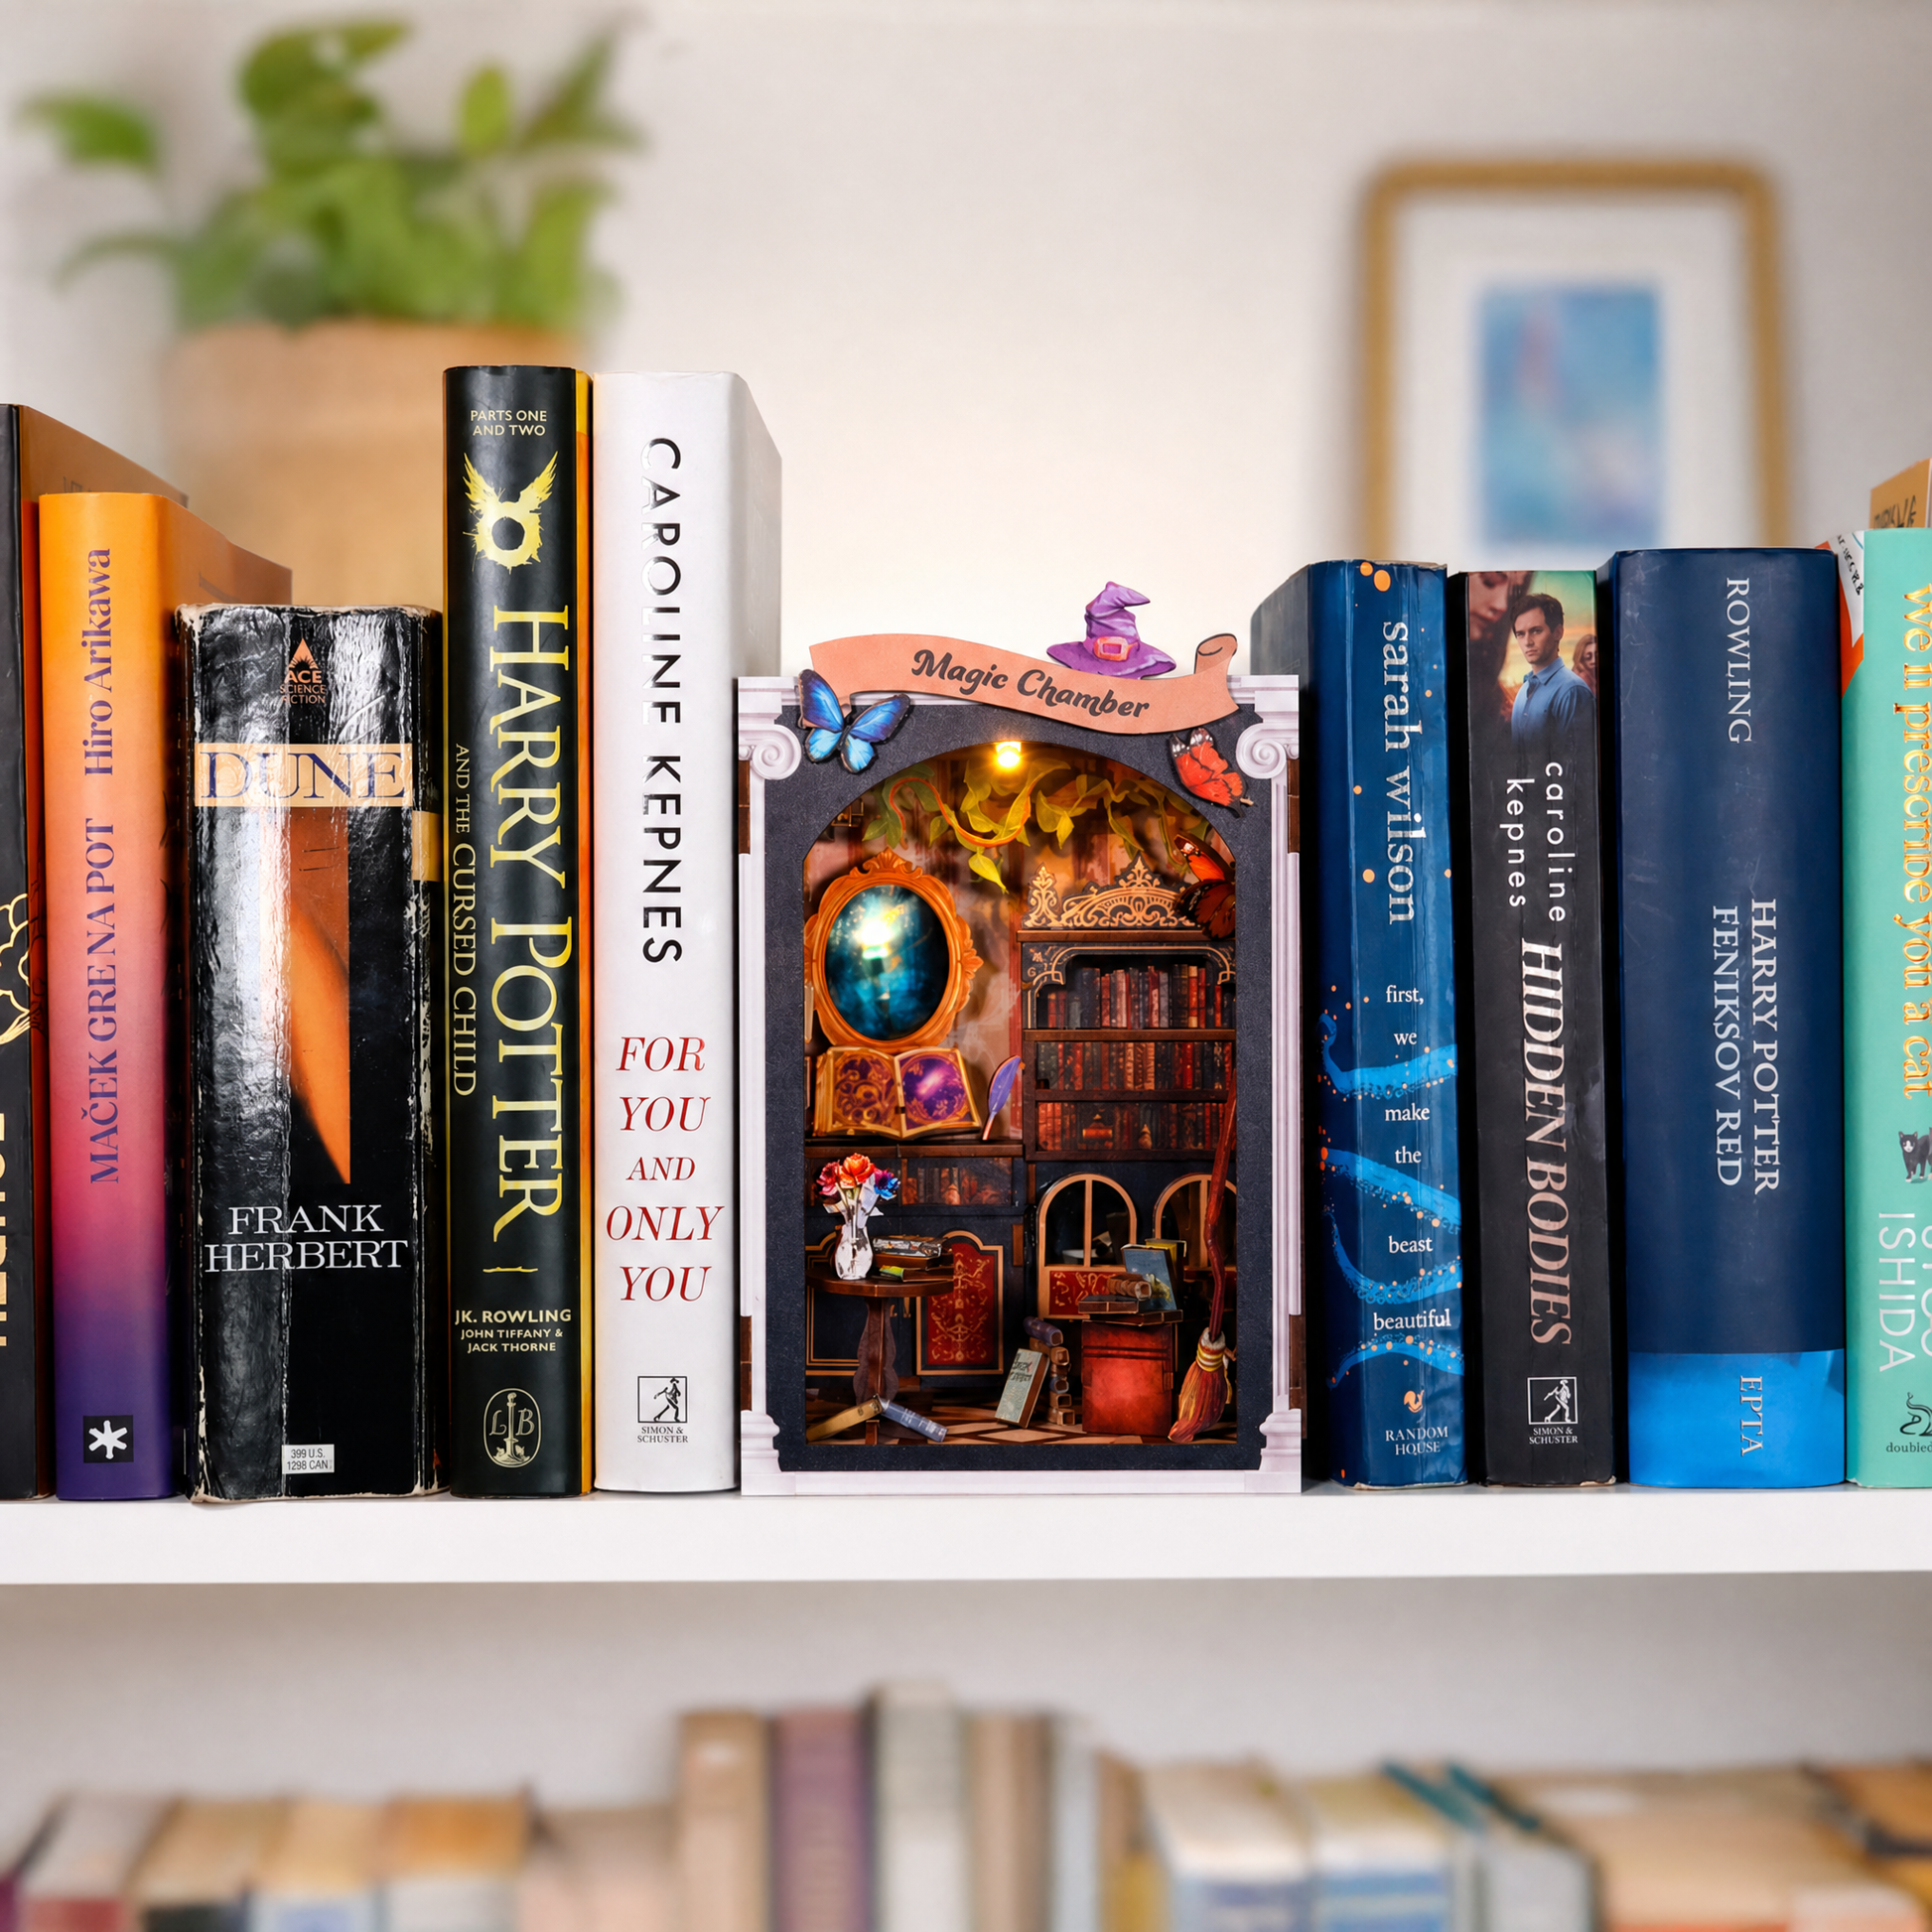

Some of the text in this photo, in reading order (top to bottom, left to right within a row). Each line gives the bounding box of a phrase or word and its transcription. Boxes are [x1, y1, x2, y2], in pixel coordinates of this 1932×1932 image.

[470, 409, 547, 422] PARTS ONE
[473, 424, 546, 437] AND TWO
[81, 547, 113, 776] Hiro Arikawa
[1725, 576, 1752, 745] ROWLING
[279, 684, 327, 695] SCIENCE
[284, 669, 323, 684] ACE
[910, 648, 1151, 718] Magic Chamber
[640, 437, 682, 963] CAROLINE KEPNES
[200, 751, 405, 799] DUNE
[1382, 621, 1427, 925] sarah wilson
[1499, 777, 1535, 908] kepnes
[1544, 761, 1576, 923] caroline
[453, 744, 478, 1097] AND THE CURSED CHILD
[489, 605, 573, 1243] HARRY POTTER
[1893, 910, 1932, 991] you
[80, 817, 118, 1184] MAČEK GRE NA POT
[1385, 985, 1425, 1005] first,
[1903, 1001, 1931, 1026] a
[1393, 1030, 1418, 1045] we
[1713, 904, 1743, 1186] FENIKSOV RED
[1750, 897, 1780, 1195] HARRY POTTER
[616, 1035, 706, 1072] FOR
[1903, 1035, 1932, 1100] cat
[620, 1096, 711, 1133] YOU
[1384, 1103, 1431, 1122] make
[1394, 1147, 1422, 1165] the
[1521, 937, 1572, 1346] HIDDEN BODIES
[626, 1156, 696, 1181] AND
[227, 1204, 384, 1235] FRANK
[606, 1204, 725, 1242] ONLY
[204, 1240, 409, 1273] HERBERT
[1388, 1235, 1434, 1254] beast
[620, 1265, 712, 1303] YOU
[1878, 1212, 1916, 1373] ISHIDA
[454, 1309, 572, 1325] JK. ROWLING
[1373, 1309, 1451, 1331] beautiful
[461, 1328, 563, 1340] JOHN TIFFANY &
[467, 1342, 557, 1354] JACK THORNE
[515, 1407, 535, 1437] B
[640, 1426, 684, 1435] SIMON &
[1738, 1374, 1763, 1457] EPTA
[636, 1435, 689, 1444] SCHUSTER
[1385, 1426, 1449, 1442] RANDOM
[1529, 1435, 1579, 1445] SCHUSTER
[1533, 1426, 1574, 1436] SIMON &
[290, 1449, 307, 1459] 399
[1395, 1441, 1441, 1456] HOUSE
[287, 1459, 307, 1470] 1298
